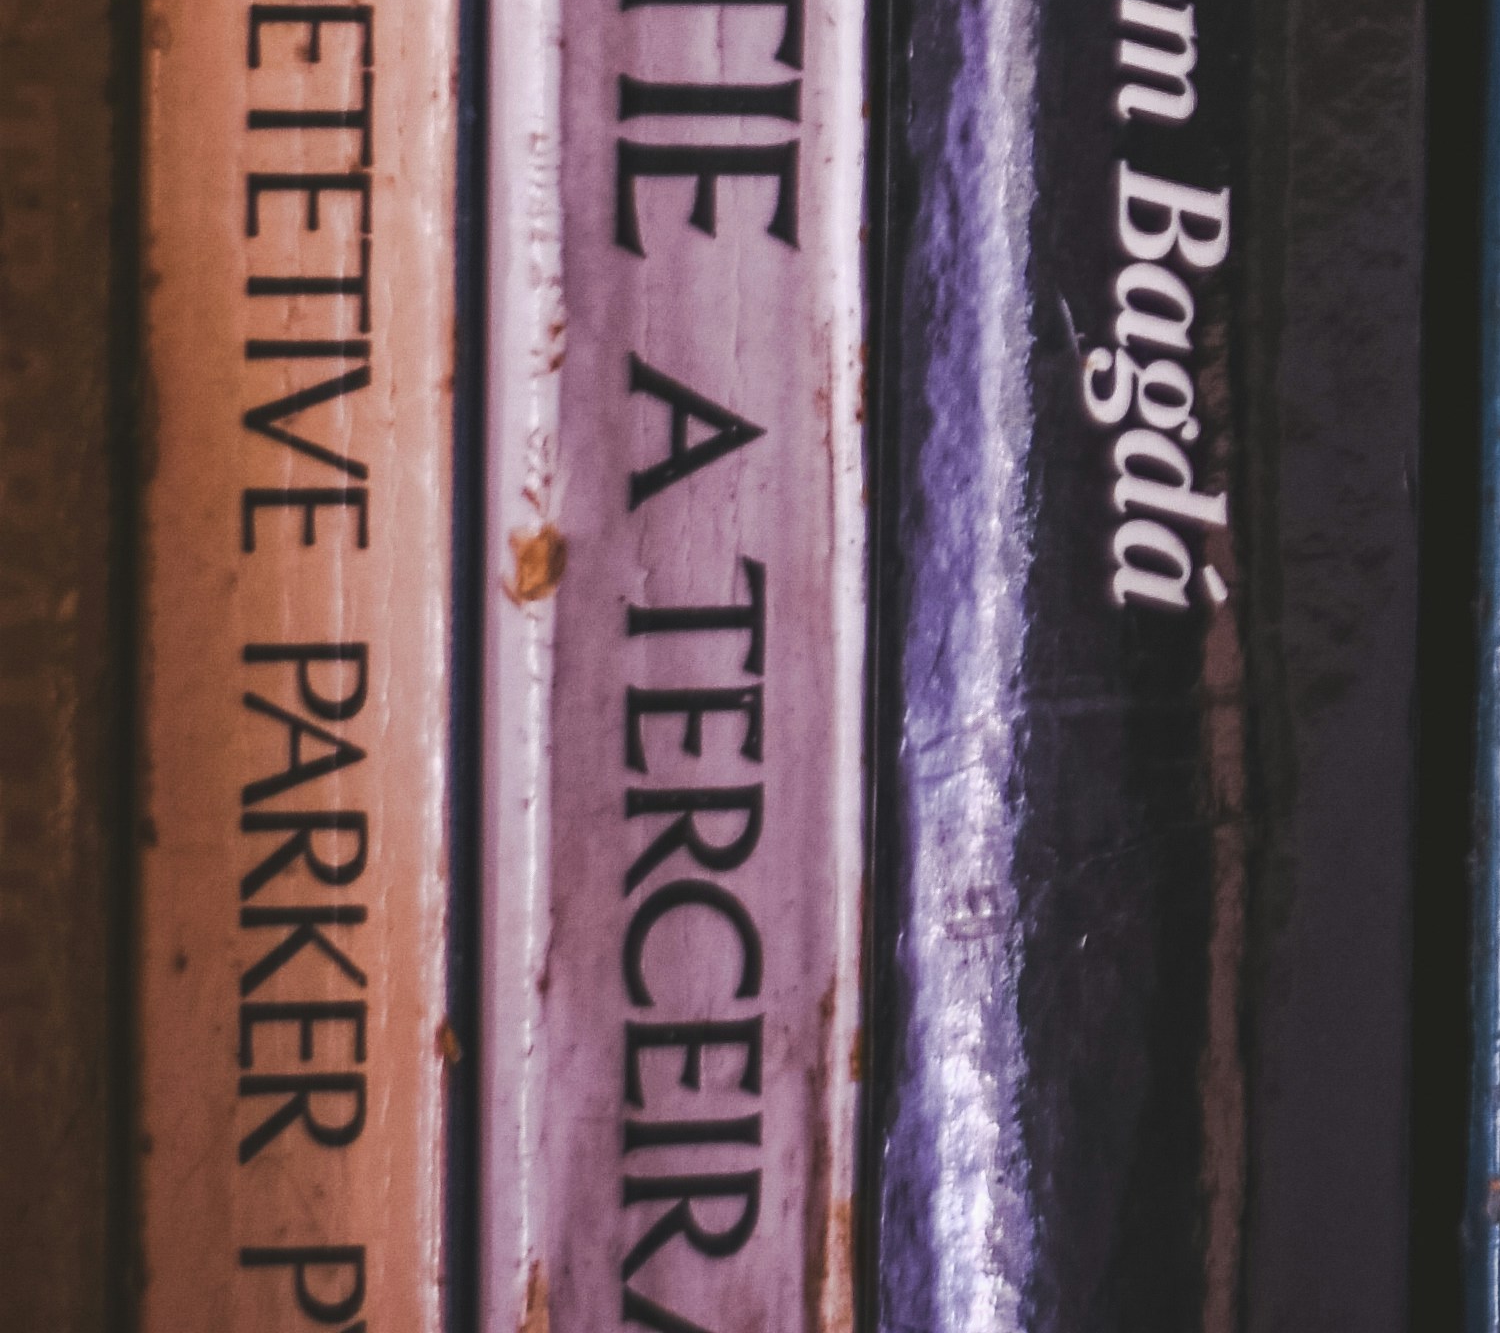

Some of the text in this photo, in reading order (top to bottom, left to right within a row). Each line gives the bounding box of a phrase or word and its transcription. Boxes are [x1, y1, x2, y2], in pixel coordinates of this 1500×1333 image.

[630, 351, 766, 513] A
[1082, 159, 1231, 613] Bagdá
[239, 642, 368, 1165] PARKER
[239, 1245, 366, 1333] P
